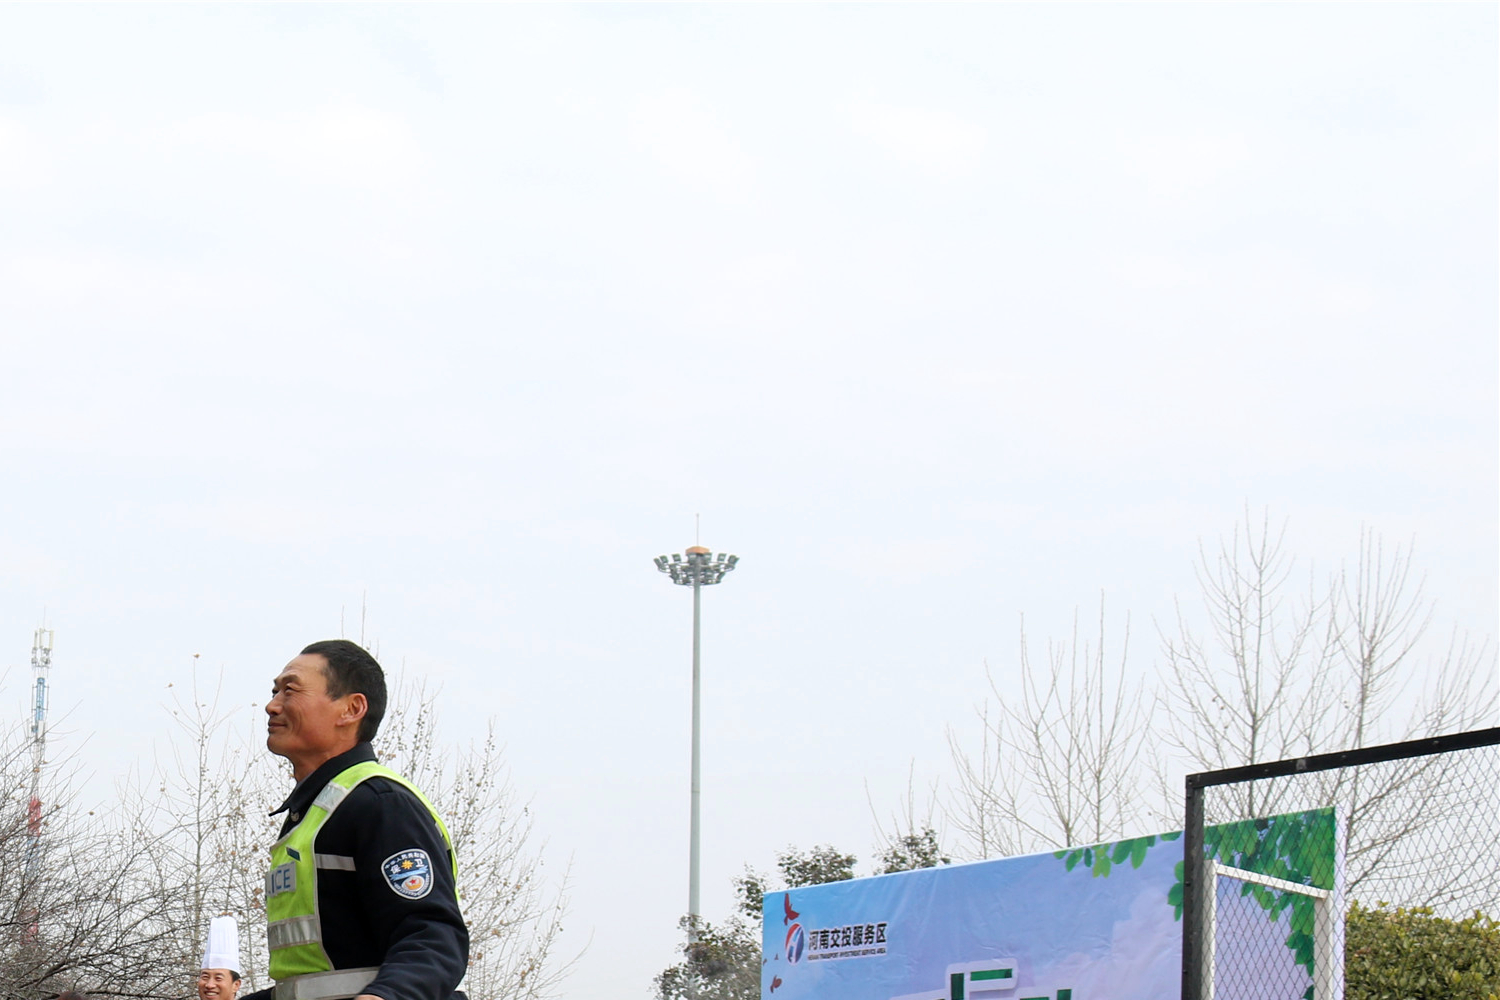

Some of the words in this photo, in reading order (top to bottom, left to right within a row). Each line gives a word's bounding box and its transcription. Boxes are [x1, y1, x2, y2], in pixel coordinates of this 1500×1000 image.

[808, 923, 887, 950] 河南交投服务区
